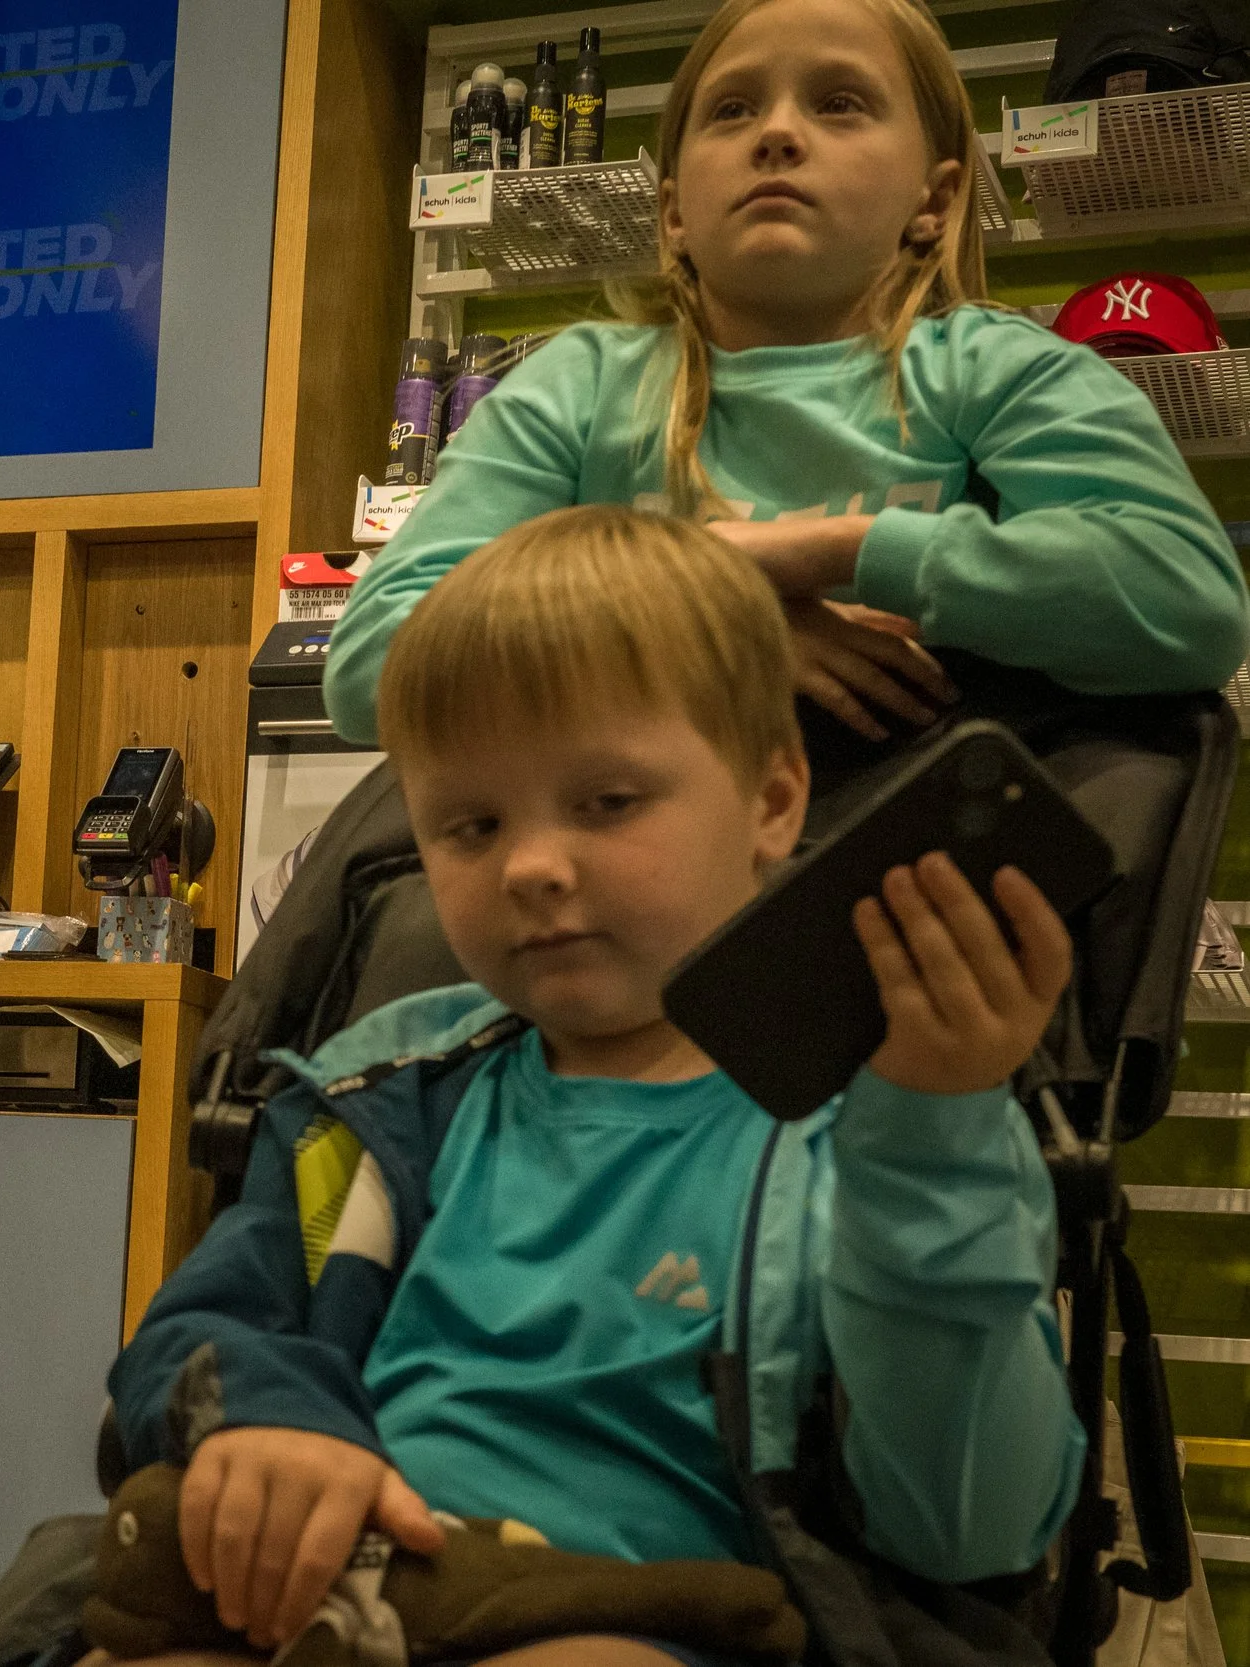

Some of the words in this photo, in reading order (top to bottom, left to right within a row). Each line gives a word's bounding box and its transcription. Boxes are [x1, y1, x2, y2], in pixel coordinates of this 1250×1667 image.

[567, 98, 604, 111] Martens
[470, 122, 489, 131] SPORTS
[1017, 130, 1047, 142] schuh
[1053, 128, 1079, 138] kids
[424, 198, 450, 207] schuh
[455, 195, 477, 204] kids
[1101, 279, 1153, 321] NY
[368, 506, 393, 514] schuh
[398, 506, 414, 514] kid
[289, 590, 299, 599] 55
[302, 590, 320, 599] 1574
[322, 589, 332, 599] 05
[334, 589, 344, 598] 60
